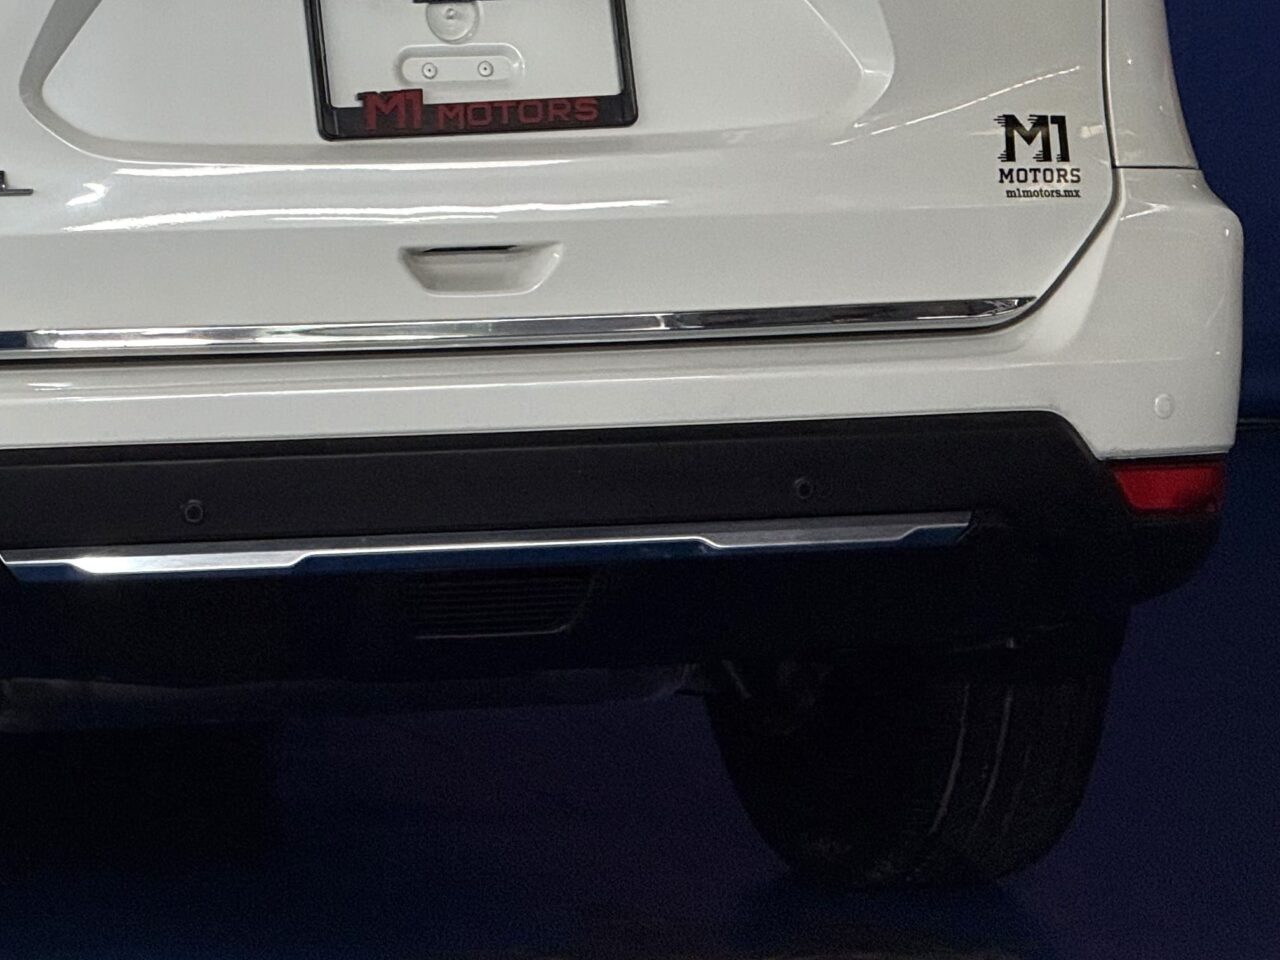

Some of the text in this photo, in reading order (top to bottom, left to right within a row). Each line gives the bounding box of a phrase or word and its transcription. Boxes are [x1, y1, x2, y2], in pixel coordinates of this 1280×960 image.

[358, 89, 600, 131] M1 MOTORS
[994, 113, 1070, 162] M1
[998, 168, 1081, 184] MOTORS
